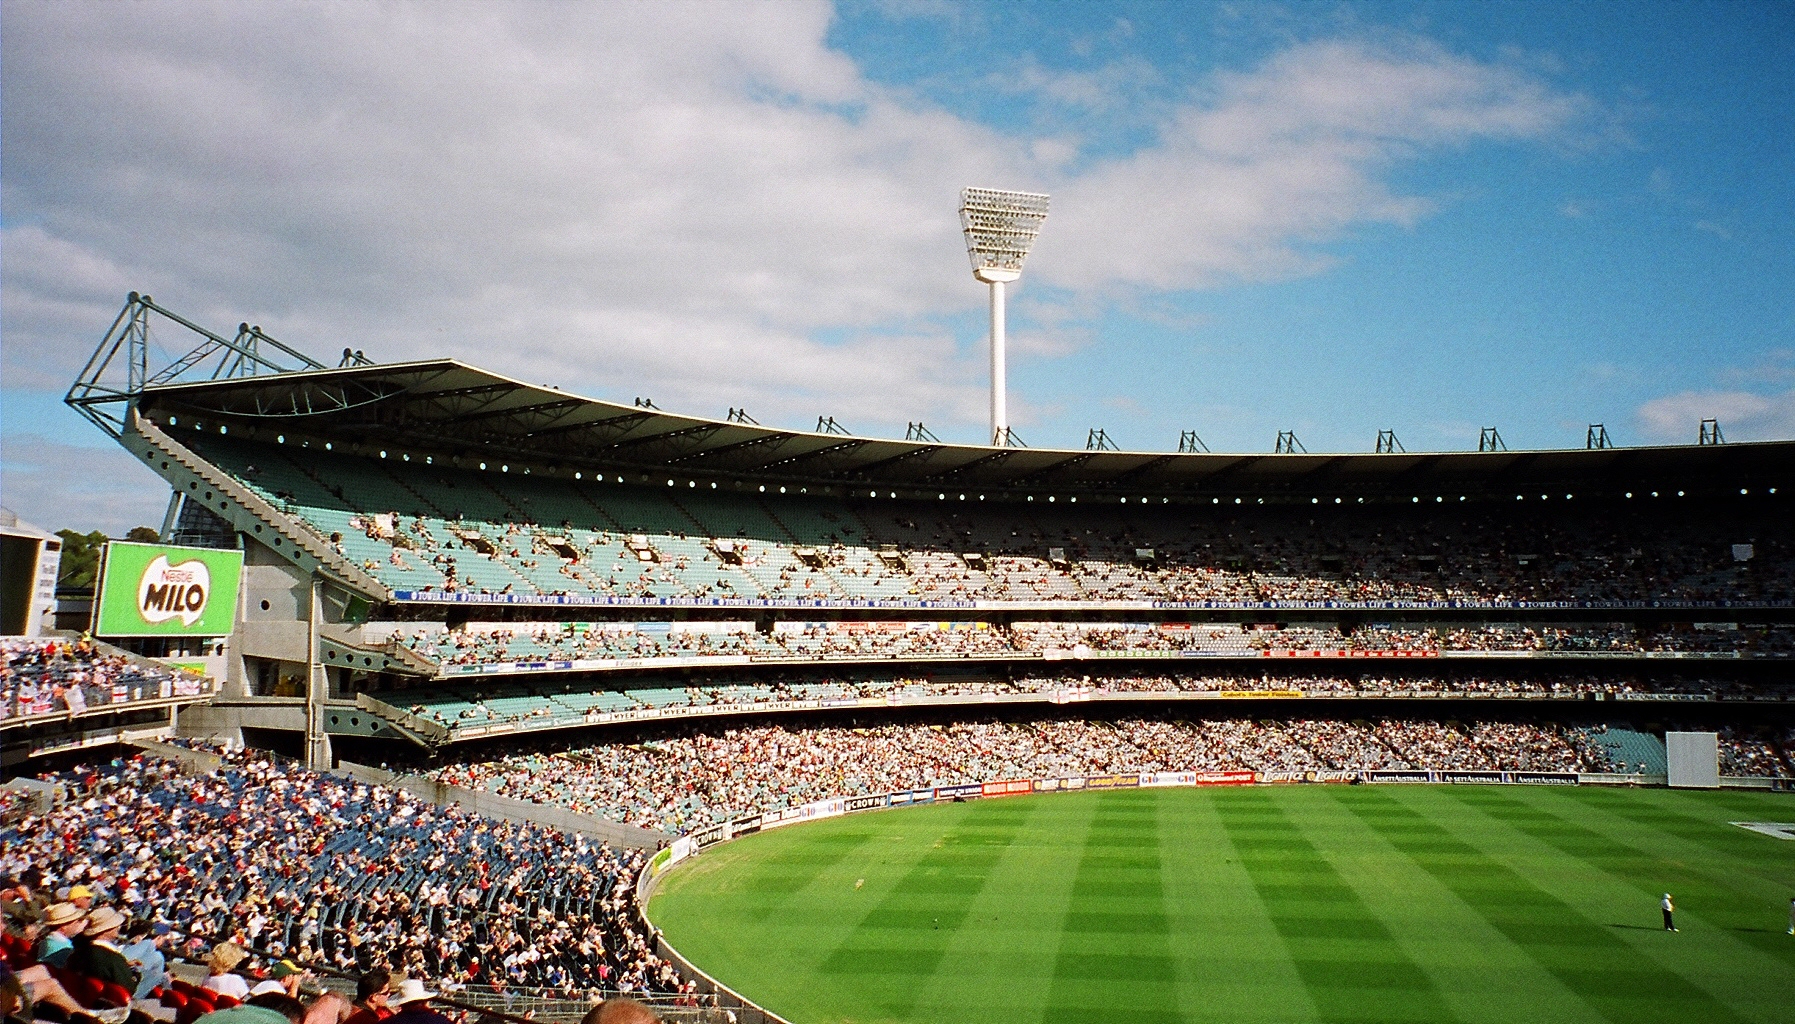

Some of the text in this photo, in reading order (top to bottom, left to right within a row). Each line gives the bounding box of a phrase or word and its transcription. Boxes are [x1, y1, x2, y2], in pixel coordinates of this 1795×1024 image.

[144, 584, 204, 612] MILO
[1089, 776, 1138, 786] GOODYEAR
[1262, 772, 1287, 782] LIGHT
[1315, 772, 1341, 782] LIGHT
[828, 802, 843, 812] GIO
[851, 797, 880, 809] CROWN
[802, 808, 816, 817] GIO
